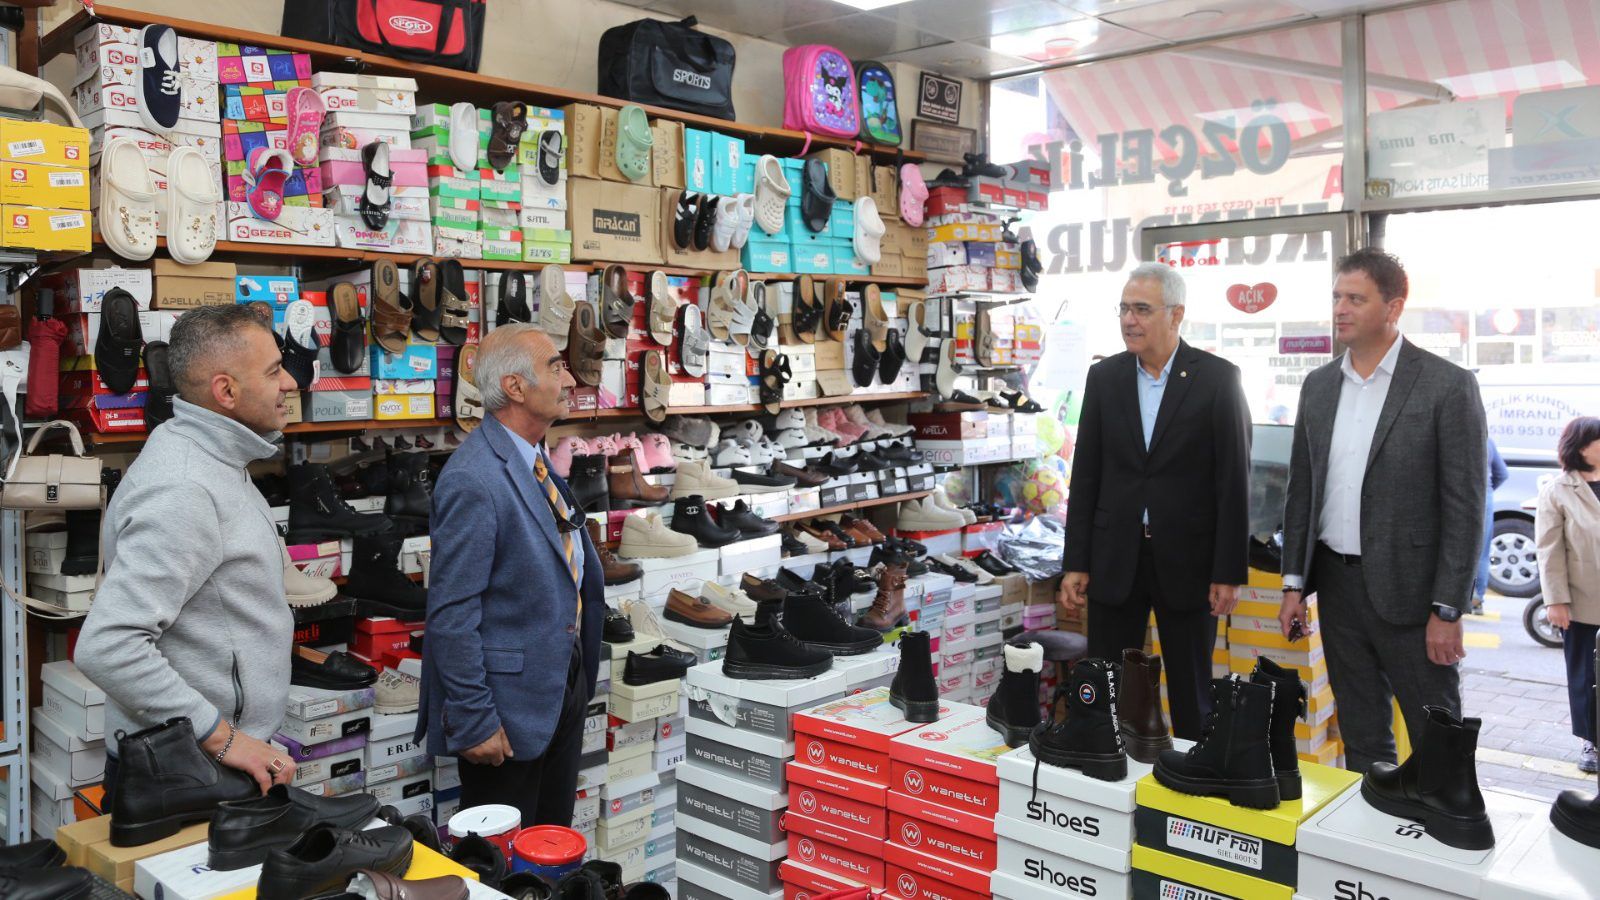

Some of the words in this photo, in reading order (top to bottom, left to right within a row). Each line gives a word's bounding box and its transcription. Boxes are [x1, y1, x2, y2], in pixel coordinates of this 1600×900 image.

[391, 17, 430, 31] SPORT
[673, 68, 711, 90] SPORTS
[137, 140, 172, 152] EZER
[250, 229, 292, 239] GEZER
[161, 297, 202, 306] APELLA
[1106, 670, 1116, 700] BLACK
[667, 753, 685, 766] ERE
[694, 747, 745, 770] wanetti
[829, 753, 879, 775] wanetti
[929, 783, 988, 807] wanetti
[685, 795, 735, 820] wanetti
[820, 803, 871, 825] wanetti
[685, 842, 735, 870] wanetti
[926, 836, 984, 860] wanetti
[819, 852, 871, 875] wanetti
